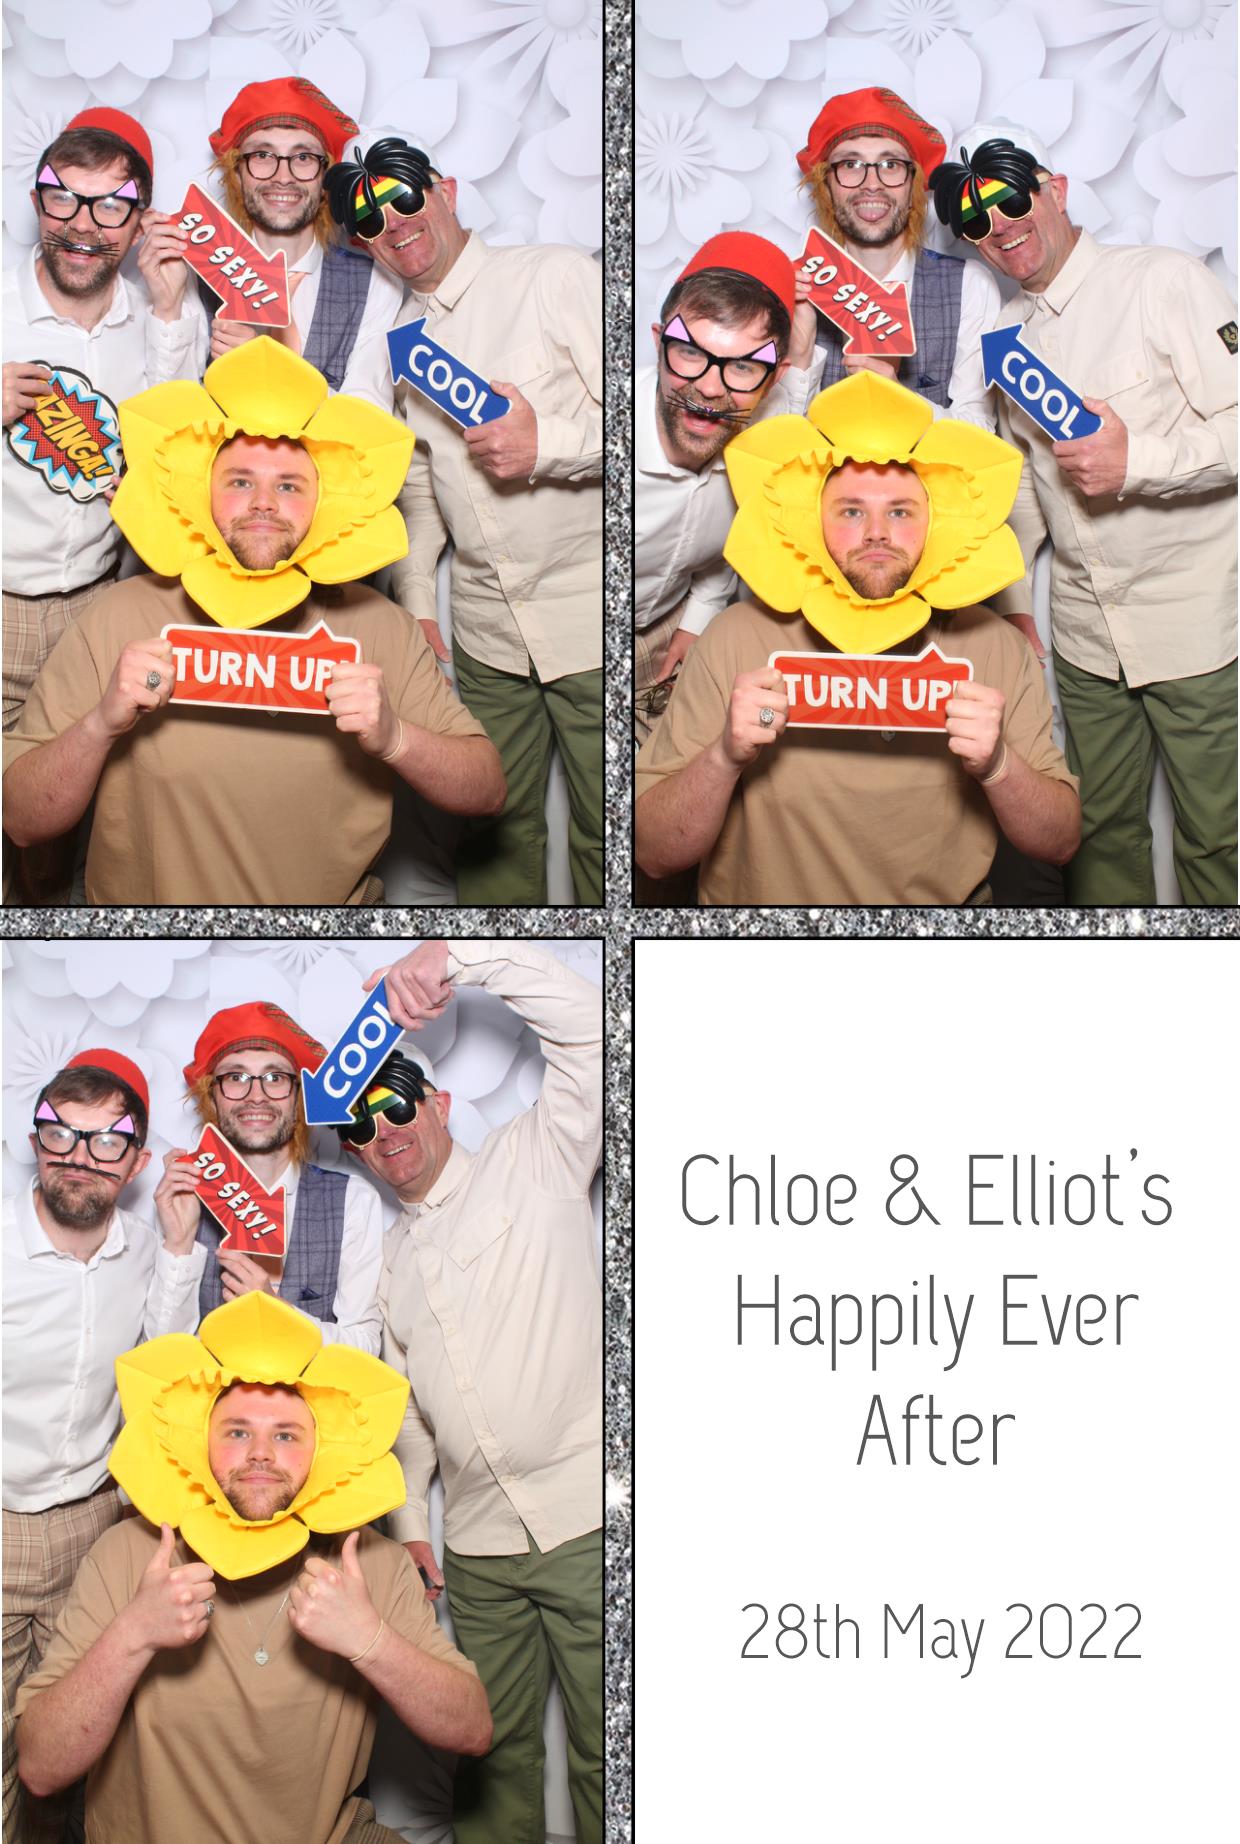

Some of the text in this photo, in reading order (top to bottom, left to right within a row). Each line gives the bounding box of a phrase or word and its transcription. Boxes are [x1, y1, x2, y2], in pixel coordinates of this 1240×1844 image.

[178, 213, 279, 309] SO SEXY!
[801, 256, 903, 341] SO SEXY!
[408, 344, 488, 424] COOL
[1002, 350, 1080, 439] COOL
[33, 388, 114, 480] AZINGA!
[172, 647, 350, 692] TURN UP
[782, 673, 888, 710] TURN
[193, 1152, 277, 1239] SO SEXY!
